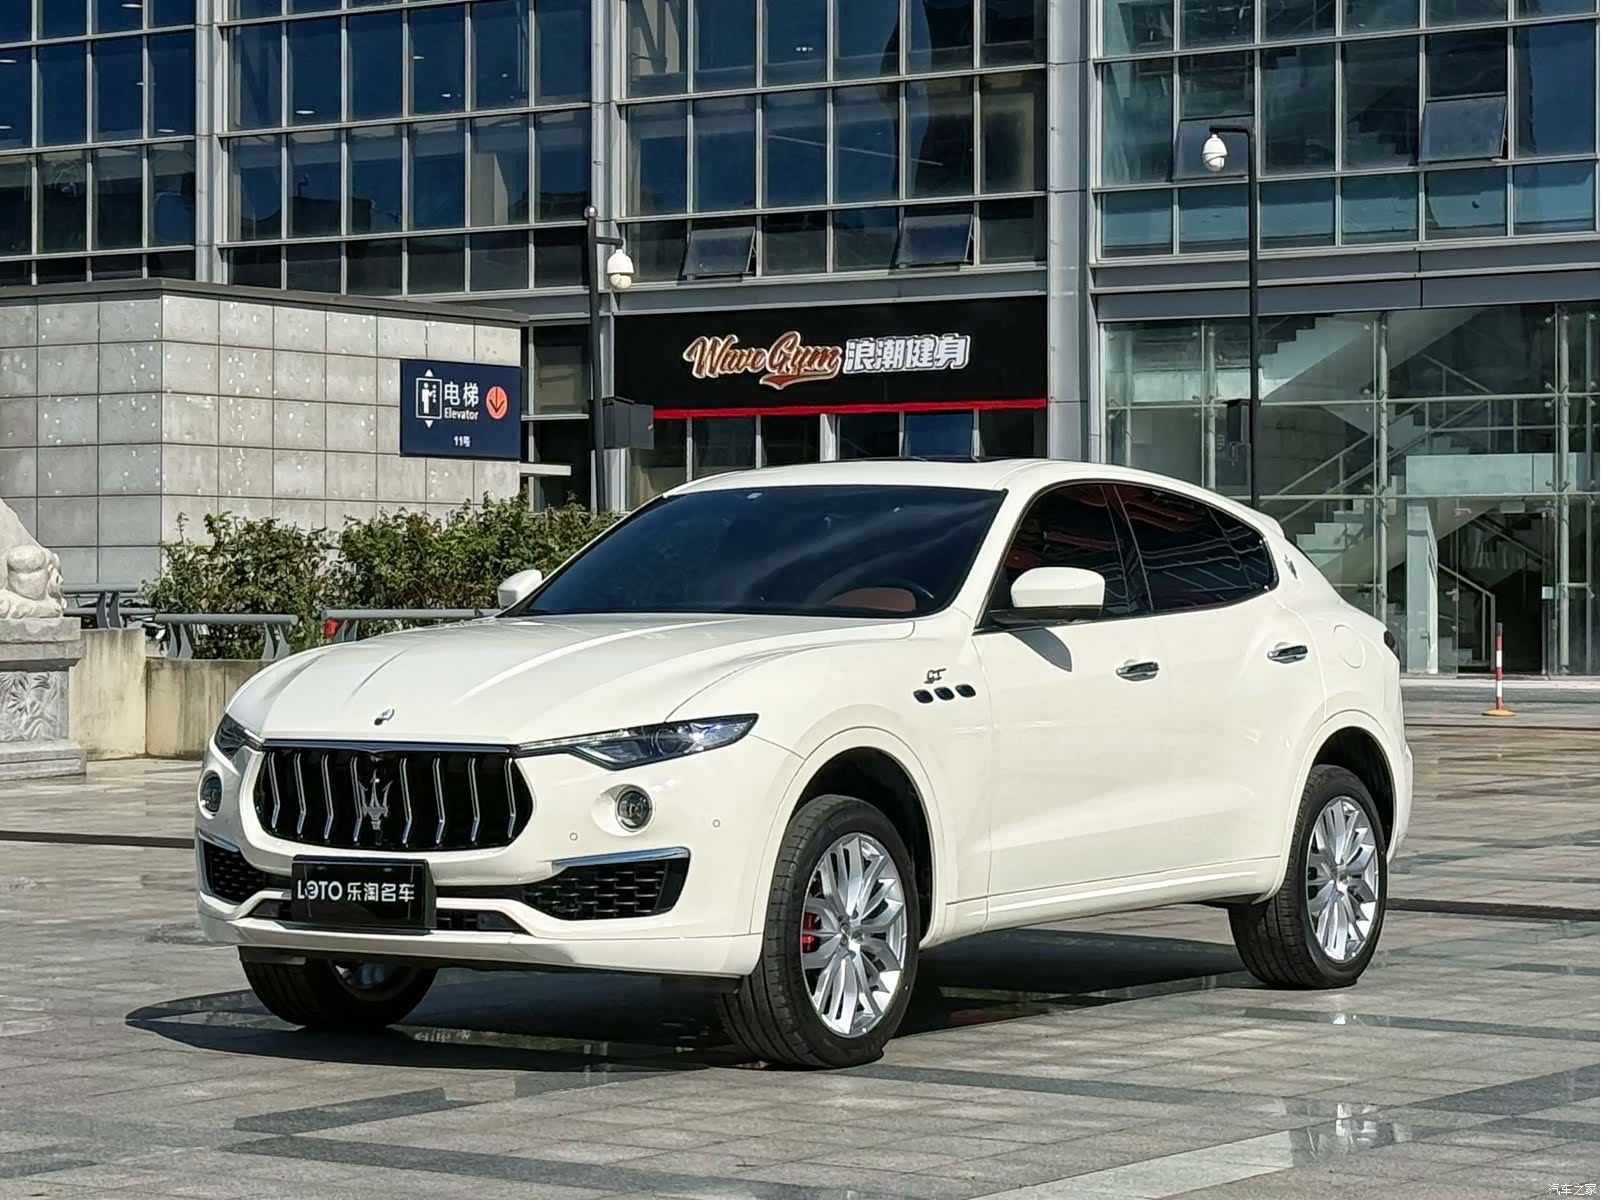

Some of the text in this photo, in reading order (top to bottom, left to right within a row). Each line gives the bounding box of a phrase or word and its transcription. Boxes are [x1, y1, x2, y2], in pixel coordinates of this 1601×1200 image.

[683, 331, 970, 384] Wave Gym 浪潮健身
[444, 381, 479, 407] 电梯
[444, 407, 479, 420] Elevator
[453, 435, 471, 447] 11号
[923, 667, 947, 684] GT
[347, 881, 415, 903] 乐淘名车
